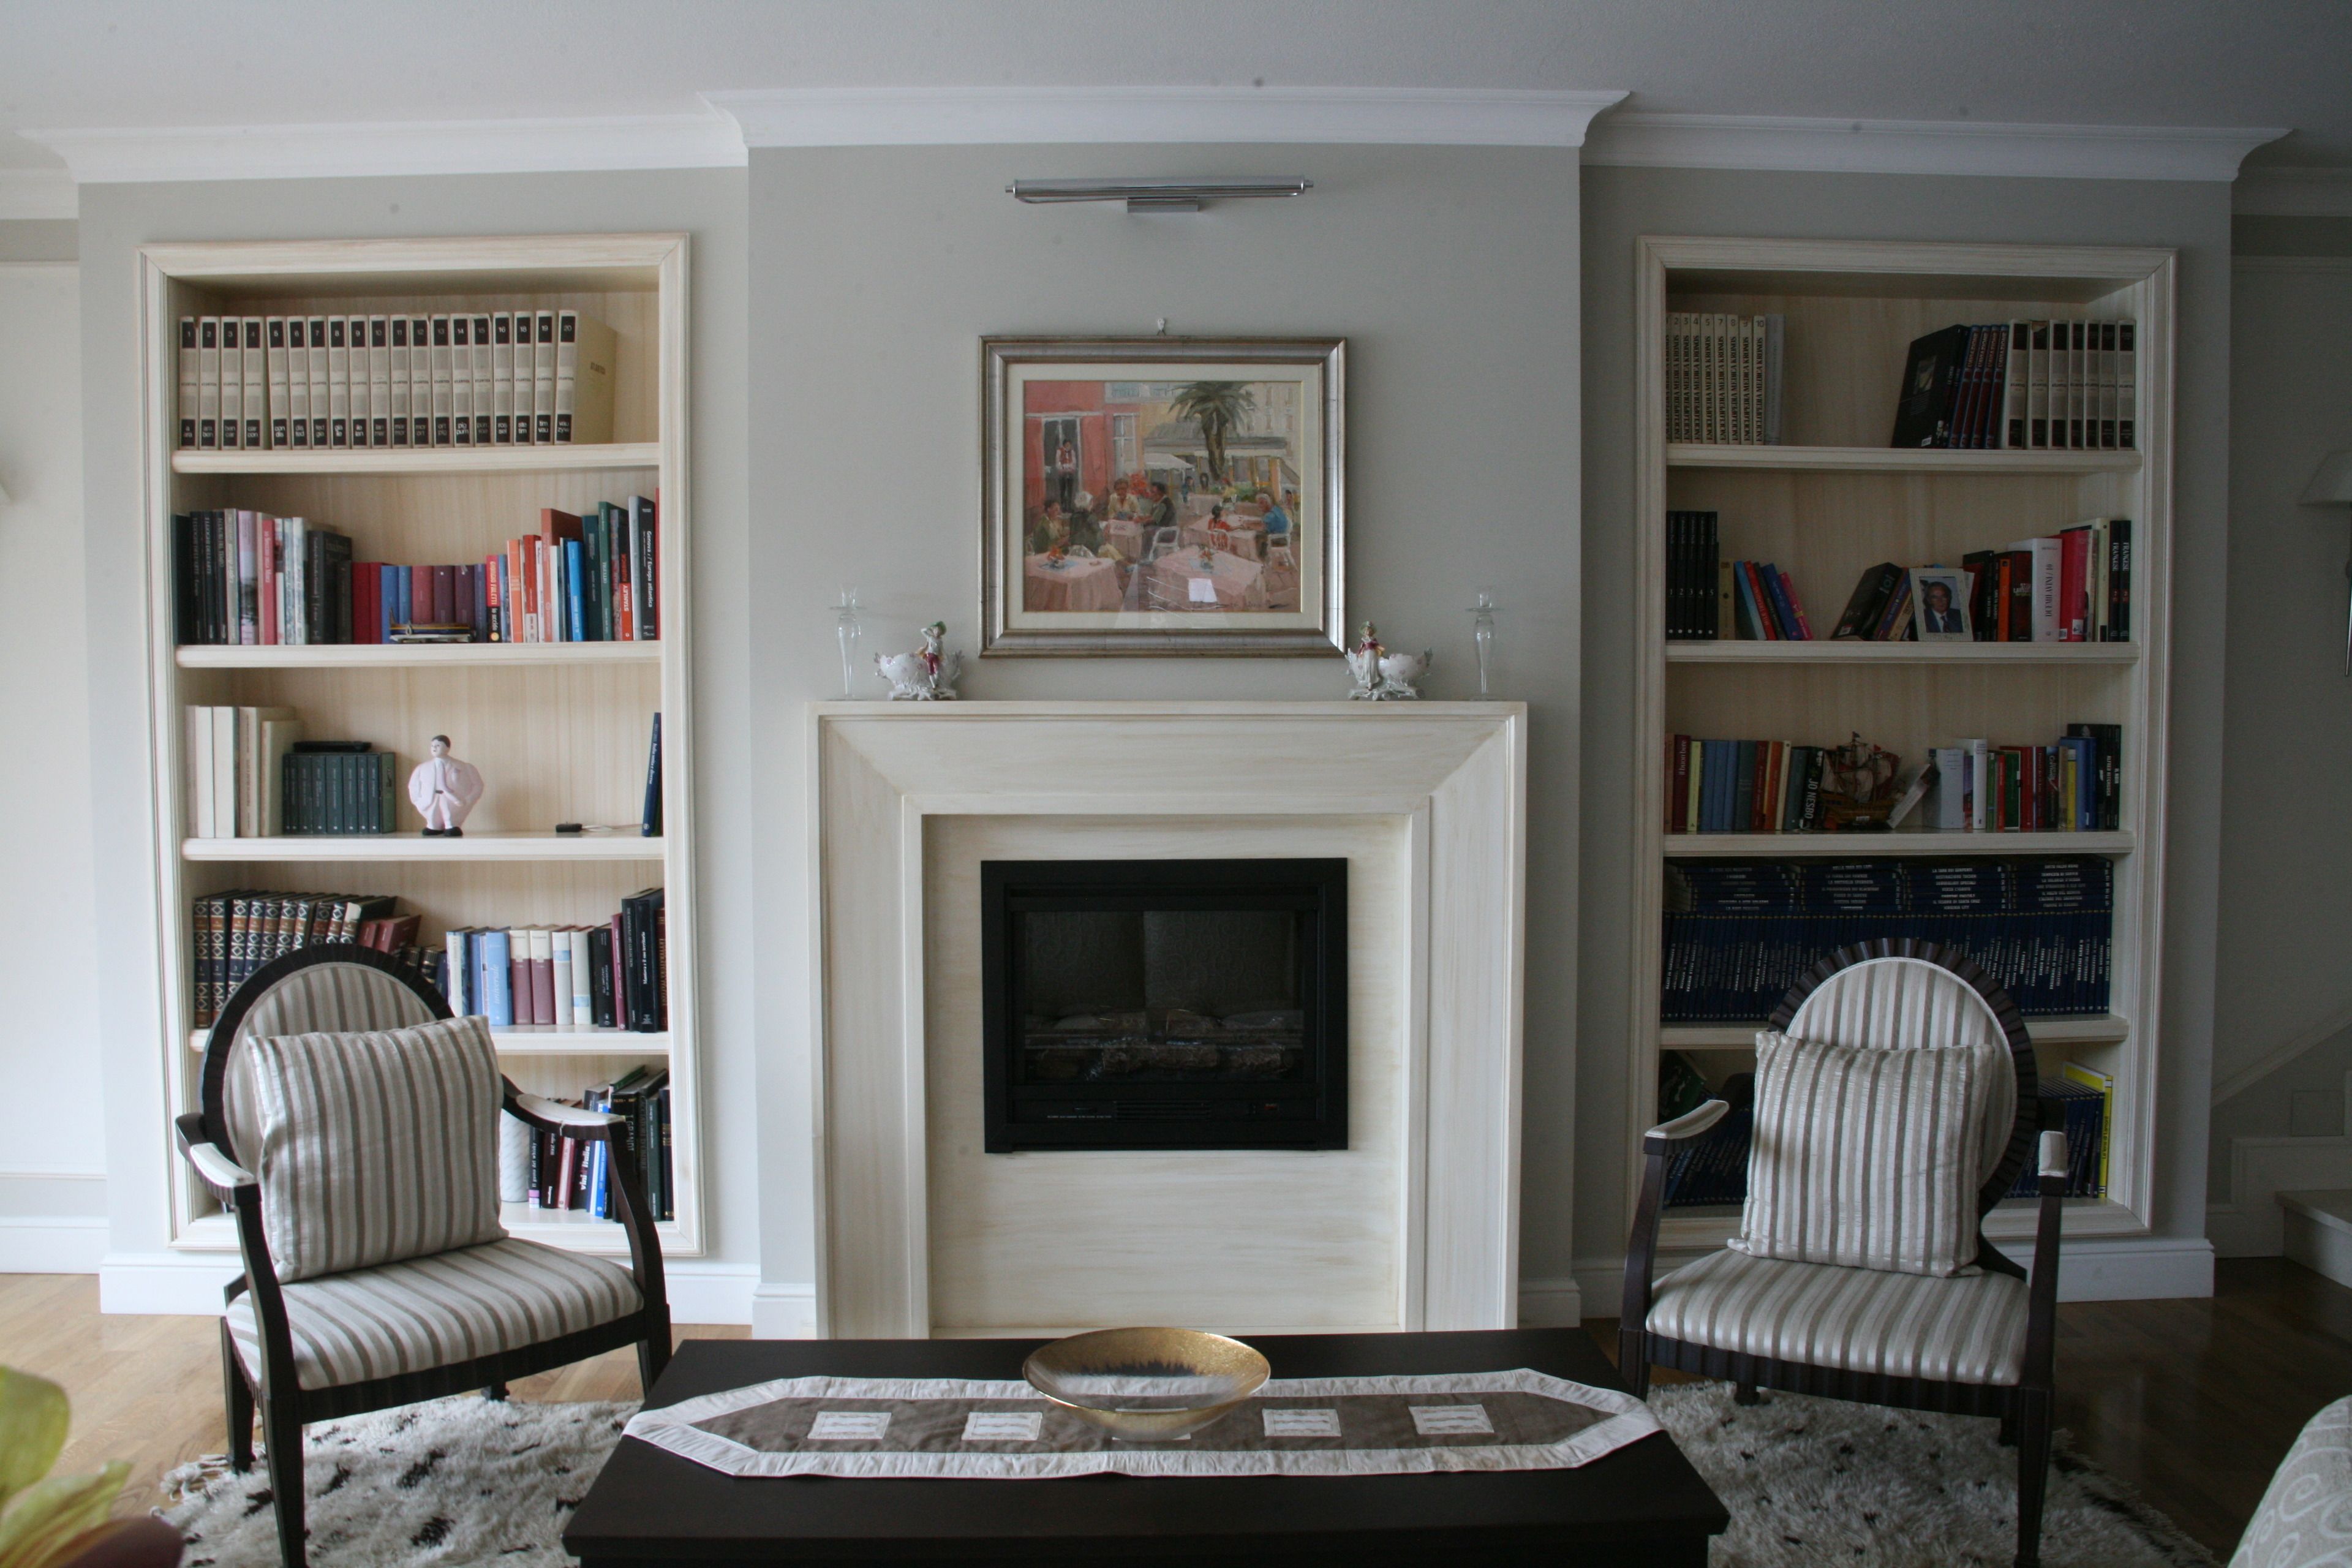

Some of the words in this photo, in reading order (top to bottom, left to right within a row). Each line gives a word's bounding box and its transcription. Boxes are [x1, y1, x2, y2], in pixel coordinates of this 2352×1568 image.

[1808, 778, 1819, 790] JO
[1804, 792, 1817, 819] NESBO
[491, 963, 500, 1005] universale
